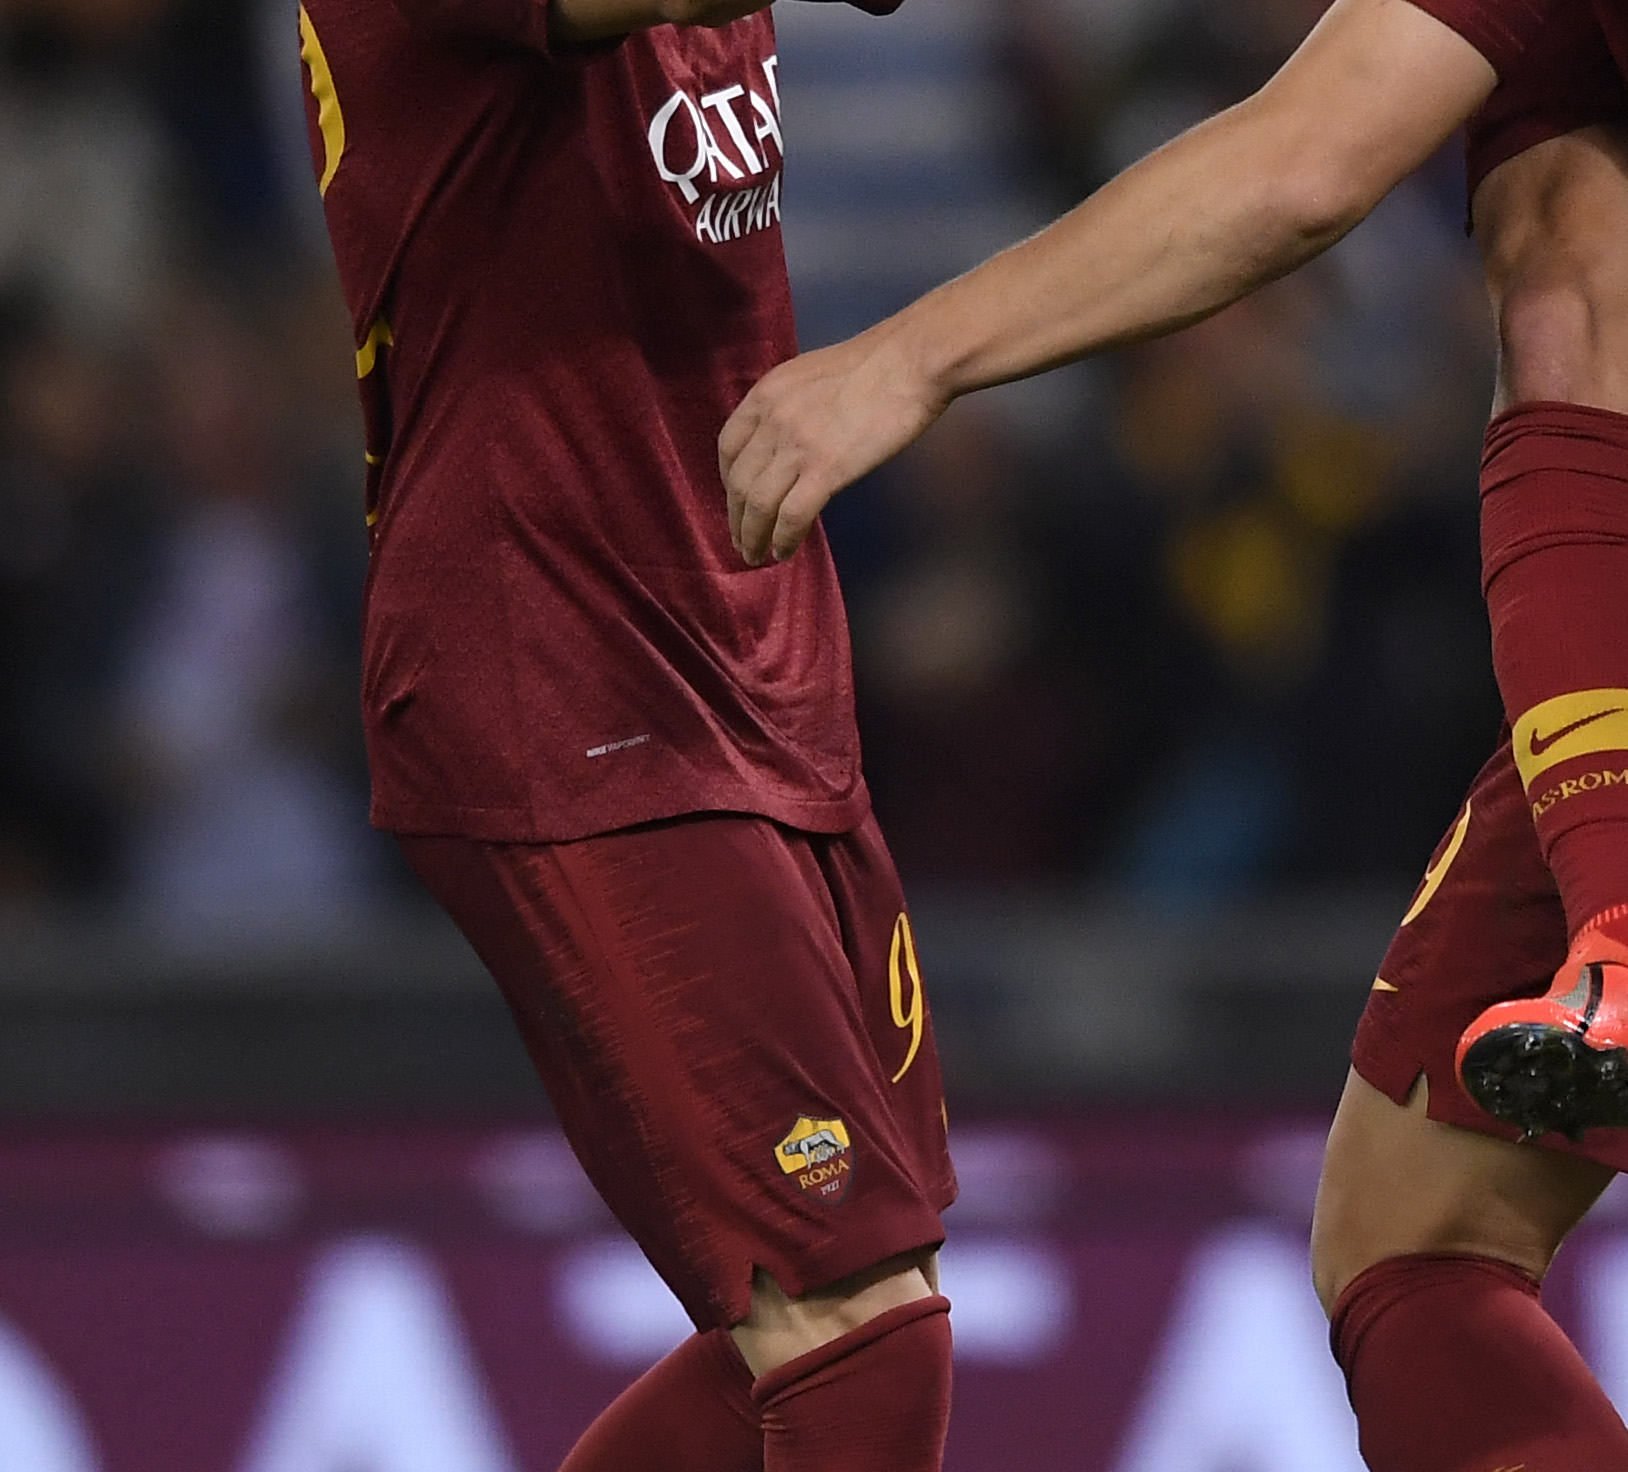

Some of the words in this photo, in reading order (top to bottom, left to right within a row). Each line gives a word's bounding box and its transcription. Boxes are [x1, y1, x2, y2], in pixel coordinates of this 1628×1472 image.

[889, 912, 923, 1083] 9
[799, 1158, 850, 1189] ROMA
[820, 1179, 840, 1196] 1927
